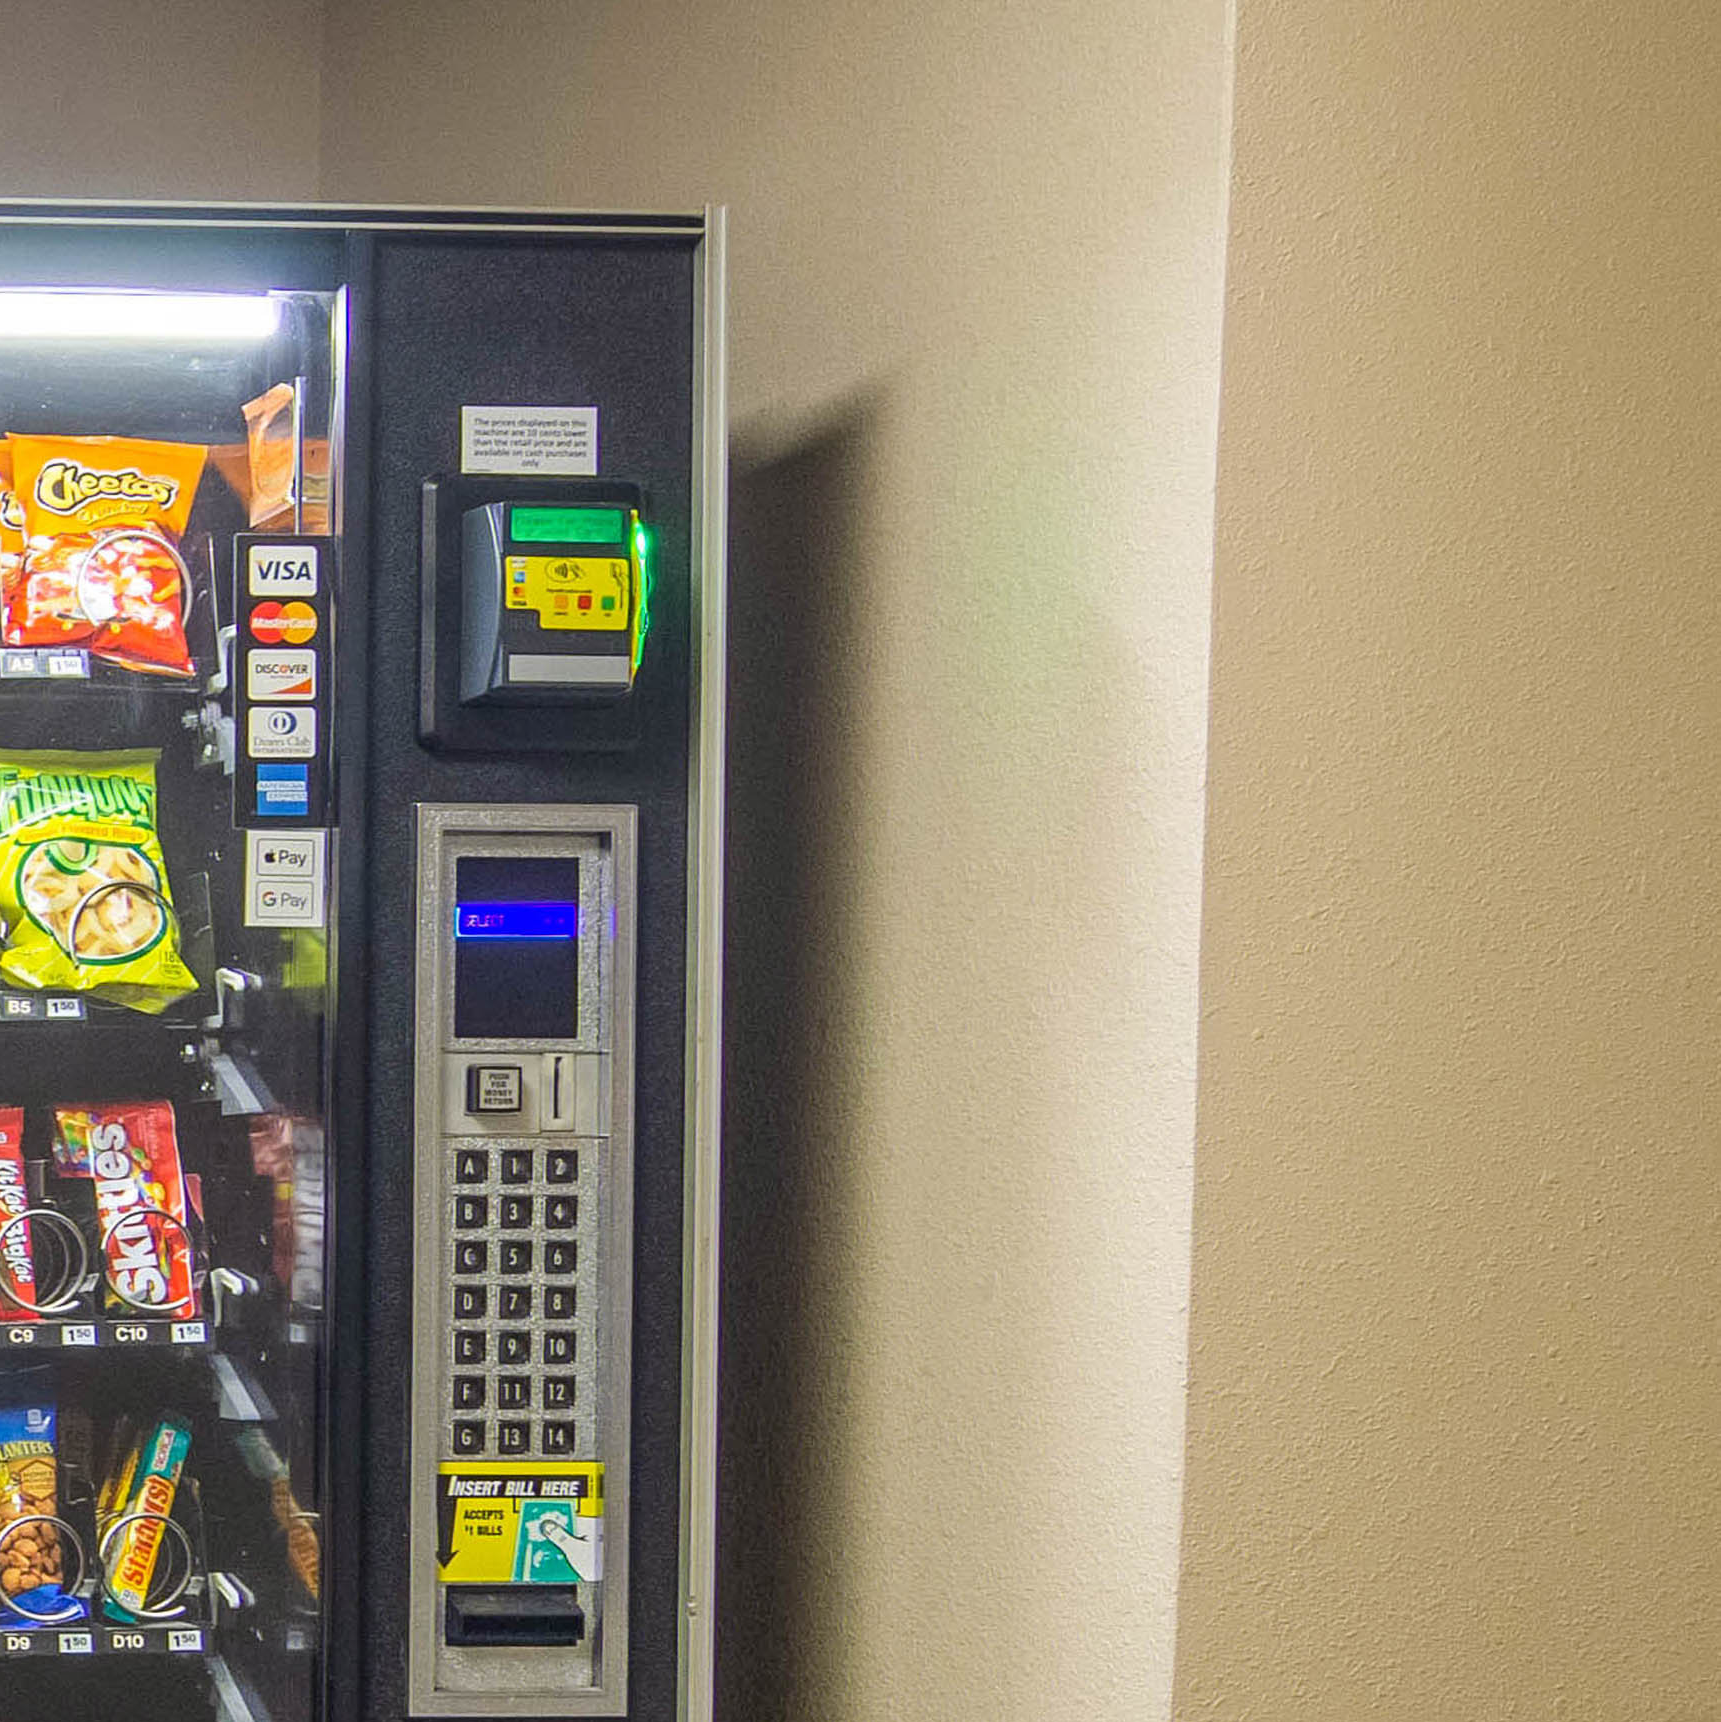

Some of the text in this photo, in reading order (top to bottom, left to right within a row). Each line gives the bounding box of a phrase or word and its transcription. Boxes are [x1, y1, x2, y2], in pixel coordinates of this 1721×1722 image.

[36, 463, 174, 509] Cheetos
[257, 560, 312, 580] VISA
[255, 664, 308, 675] DISCOVER
[277, 850, 307, 868] Pay
[280, 892, 307, 910] Pay
[7, 1001, 32, 1014] B5
[465, 1159, 474, 1175] A
[511, 1158, 517, 1174] 1
[464, 1204, 473, 1220] B
[509, 1204, 518, 1220] 3
[553, 1203, 564, 1219] 4
[509, 1249, 518, 1266] 5
[554, 1249, 562, 1265] 6
[463, 1295, 473, 1311] D
[509, 1295, 517, 1311] 7
[553, 1295, 562, 1311] 8
[9, 1329, 34, 1343] C9
[115, 1327, 148, 1341] C10
[463, 1340, 472, 1356] E
[508, 1340, 516, 1356] 9
[549, 1339, 565, 1356] 10
[463, 1384, 471, 1400] F
[504, 1384, 521, 1400] 11
[548, 1384, 565, 1400] 12
[461, 1429, 472, 1446] G
[504, 1429, 520, 1446] 13
[548, 1429, 565, 1446] 14
[448, 1475, 580, 1497] INSERT BILL HERE
[463, 1509, 505, 1520] ACCEPTS
[476, 1525, 503, 1536] BILLS
[7, 1636, 31, 1650] D9
[112, 1635, 145, 1649] D10
